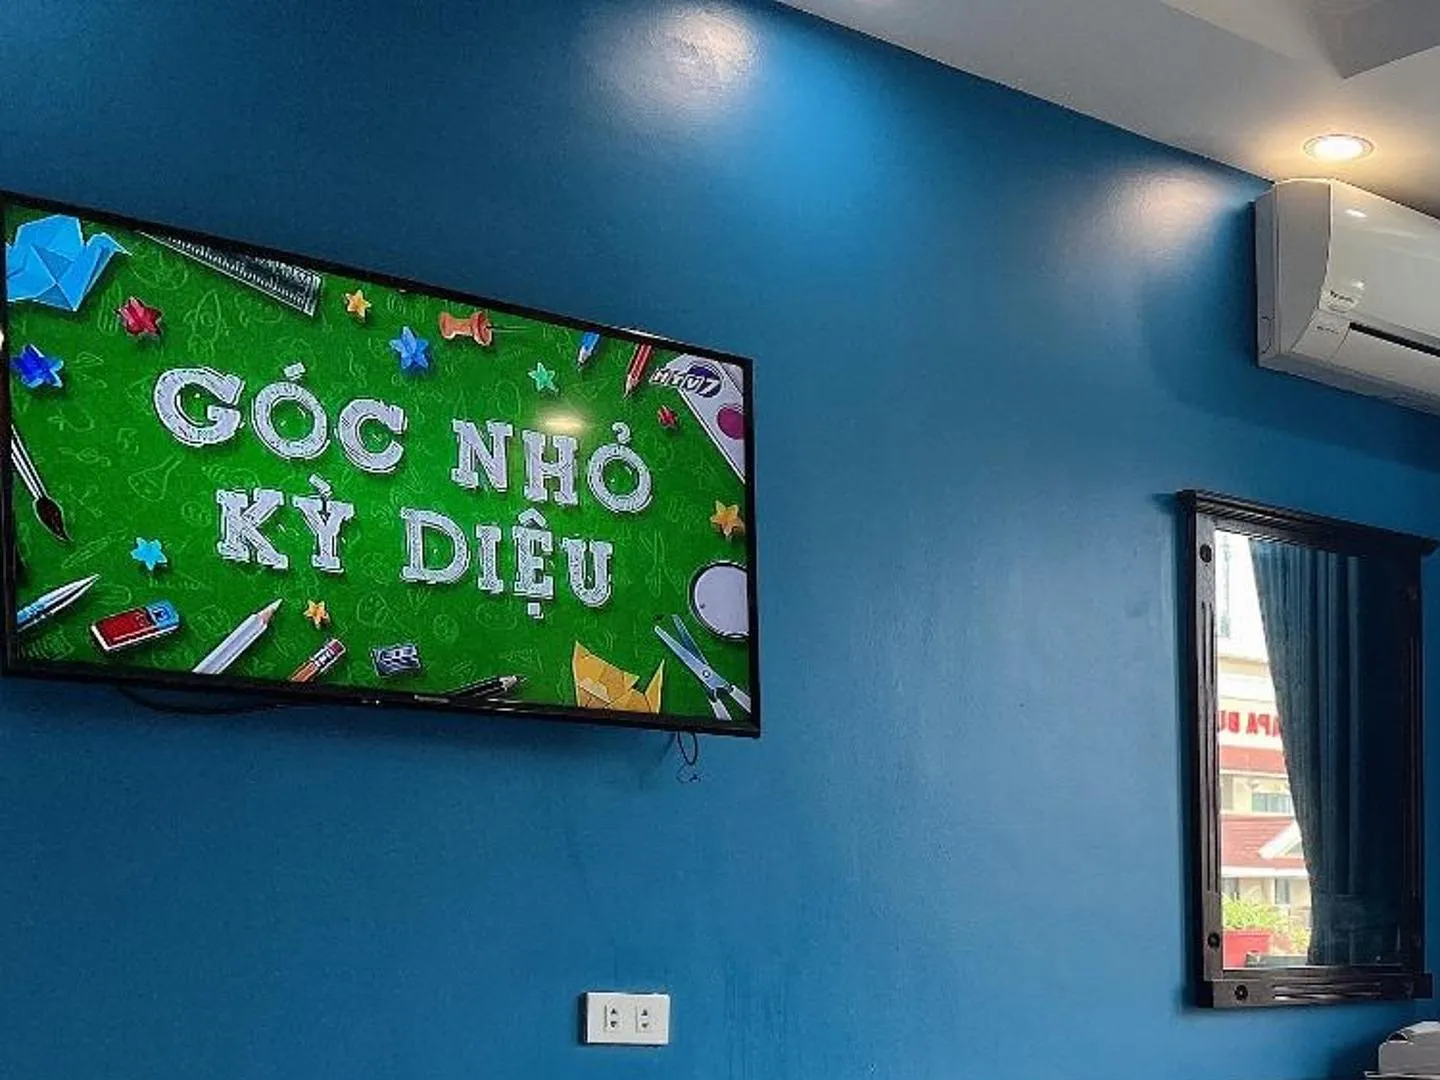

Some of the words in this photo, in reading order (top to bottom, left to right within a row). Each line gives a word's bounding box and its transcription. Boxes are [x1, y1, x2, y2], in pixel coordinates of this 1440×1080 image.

[154, 362, 408, 473] GÓC
[450, 419, 653, 513] NHỎ
[648, 366, 721, 397] HTV7
[216, 473, 355, 574] KỲ
[400, 507, 614, 619] DIỆU
